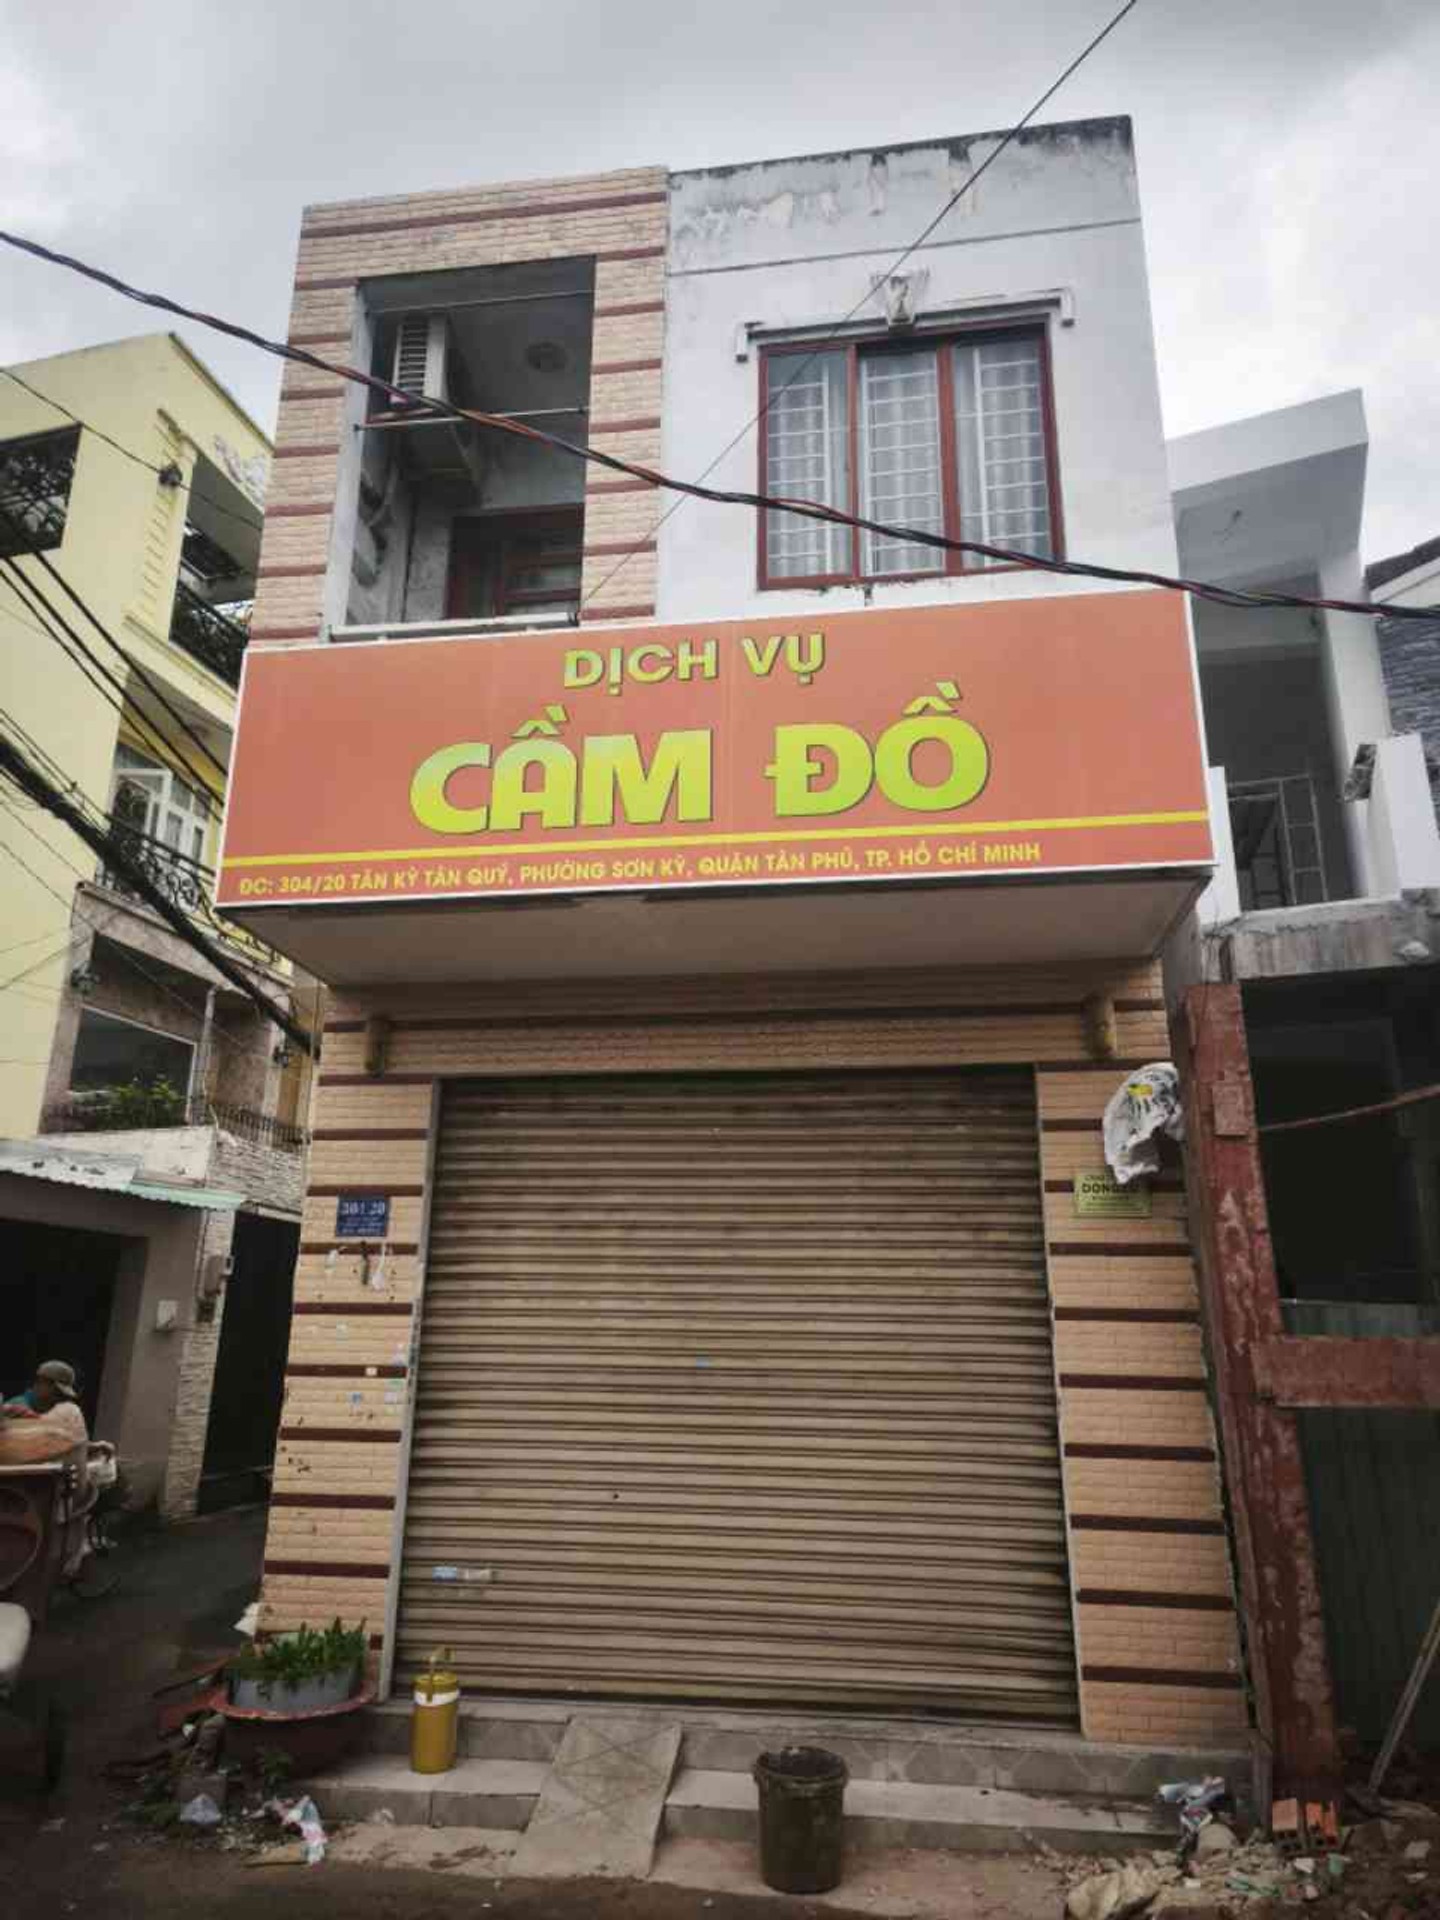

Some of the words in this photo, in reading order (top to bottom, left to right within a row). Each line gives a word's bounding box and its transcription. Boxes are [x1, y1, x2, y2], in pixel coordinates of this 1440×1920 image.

[563, 638, 719, 695] DỊCH
[741, 632, 826, 685] VỤ
[409, 704, 715, 835] CẦM
[763, 681, 991, 818] ĐỒ
[278, 874, 346, 895] 304/20
[351, 868, 388, 890] TÂN
[425, 865, 461, 888] TÂN
[520, 859, 605, 883] PHƯỜNG
[611, 857, 652, 879] SƠN
[698, 852, 759, 878] QUẬN
[766, 849, 806, 873] TÂN
[864, 849, 892, 868] TP.
[899, 840, 932, 866] HỒ
[938, 840, 977, 865] CHÍ
[983, 842, 1042, 864] MINH
